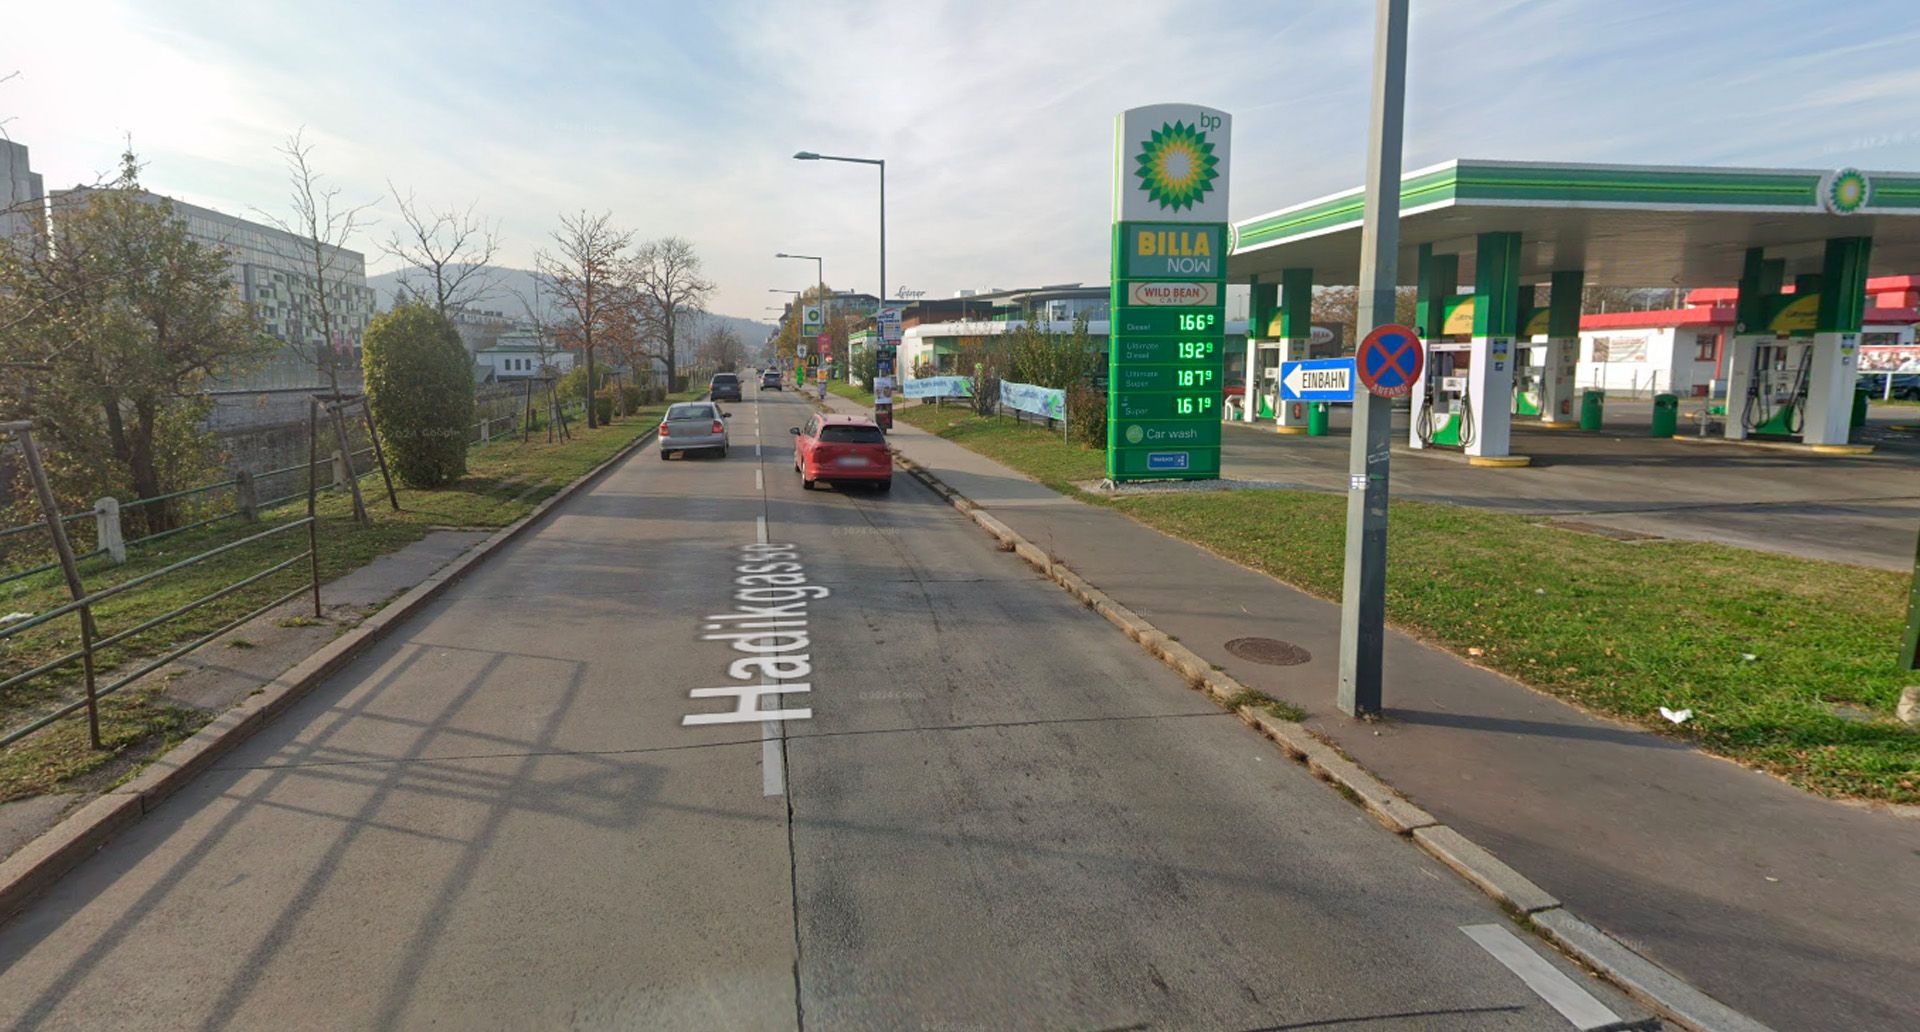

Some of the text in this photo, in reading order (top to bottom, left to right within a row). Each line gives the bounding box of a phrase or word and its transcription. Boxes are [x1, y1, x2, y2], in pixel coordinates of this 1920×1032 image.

[1200, 112, 1221, 131] bp
[1138, 231, 1210, 256] BILLA
[1168, 258, 1210, 272] NOW
[1144, 288, 1200, 297] WILD BEAN
[1302, 371, 1346, 389] EINBAHN
[1371, 384, 1408, 396] ANFANG
[1146, 428, 1198, 439] Car wash
